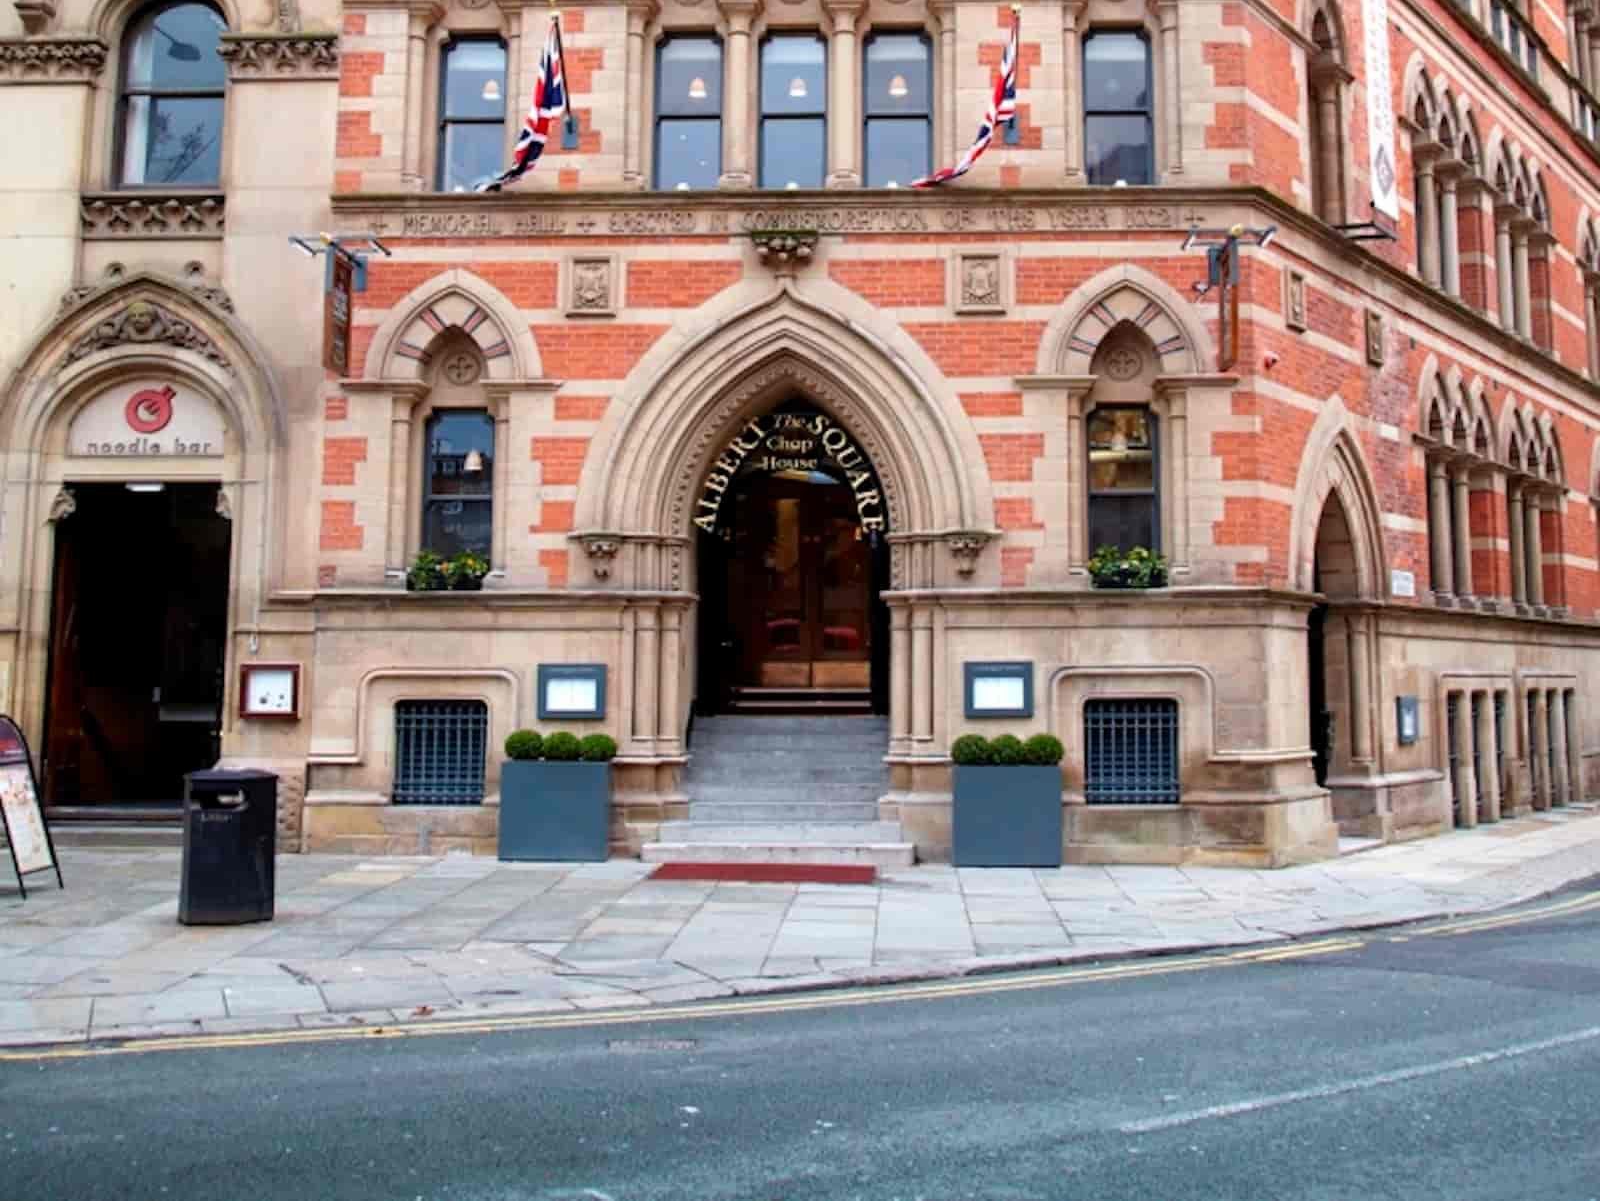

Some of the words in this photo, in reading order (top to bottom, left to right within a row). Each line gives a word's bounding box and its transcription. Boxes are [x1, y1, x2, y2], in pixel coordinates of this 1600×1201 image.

[87, 437, 161, 454] noodle
[174, 436, 212, 454] bar
[766, 435, 813, 454] Chop
[754, 456, 818, 471] House
[693, 415, 768, 534] ALBERT
[807, 415, 887, 533] SQUARE
